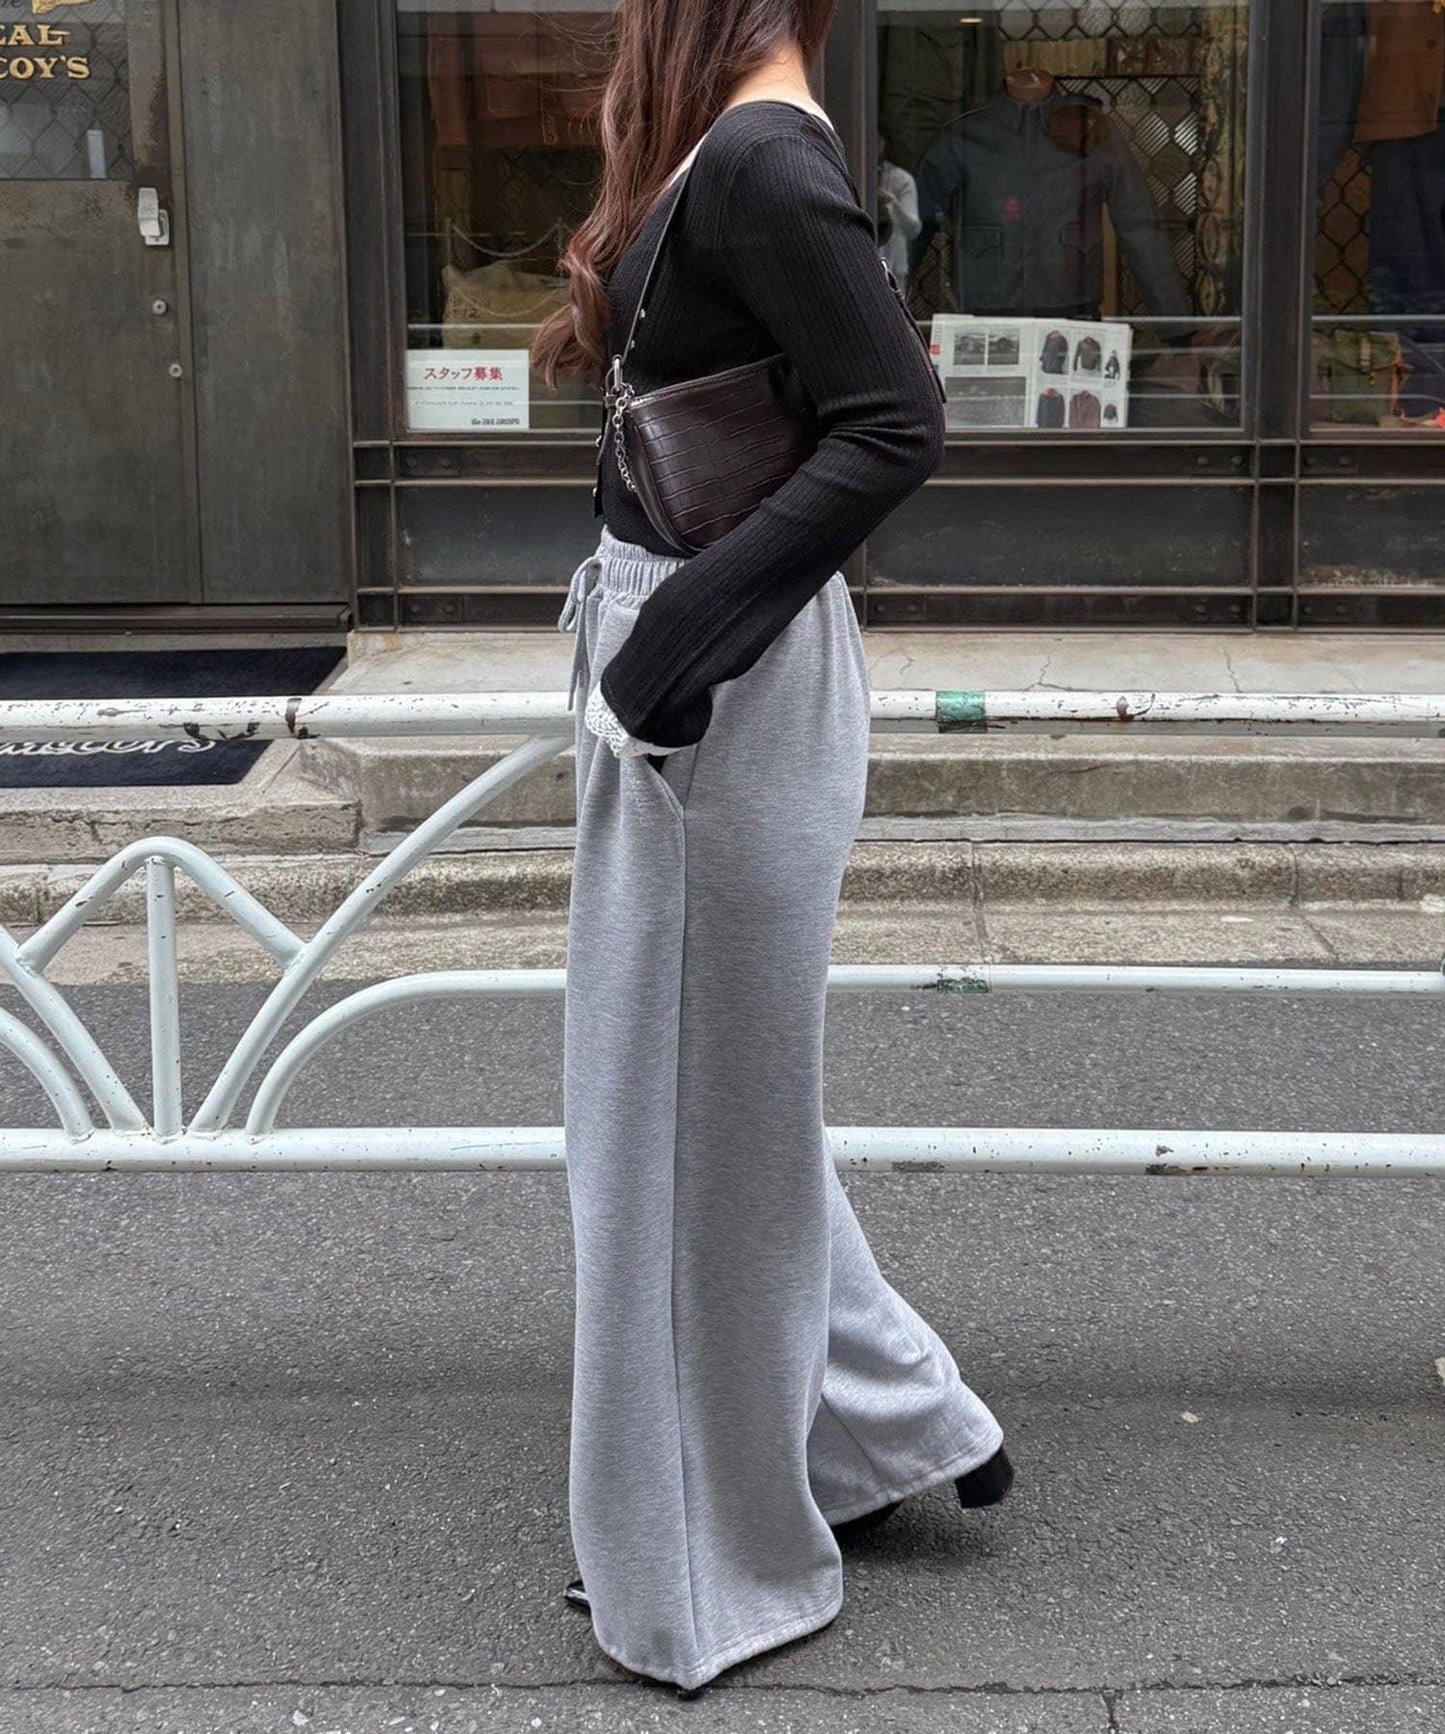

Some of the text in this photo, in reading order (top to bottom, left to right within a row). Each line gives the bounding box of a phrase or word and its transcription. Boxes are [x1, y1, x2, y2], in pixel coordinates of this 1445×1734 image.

[424, 366, 504, 382] スタッフ募集
